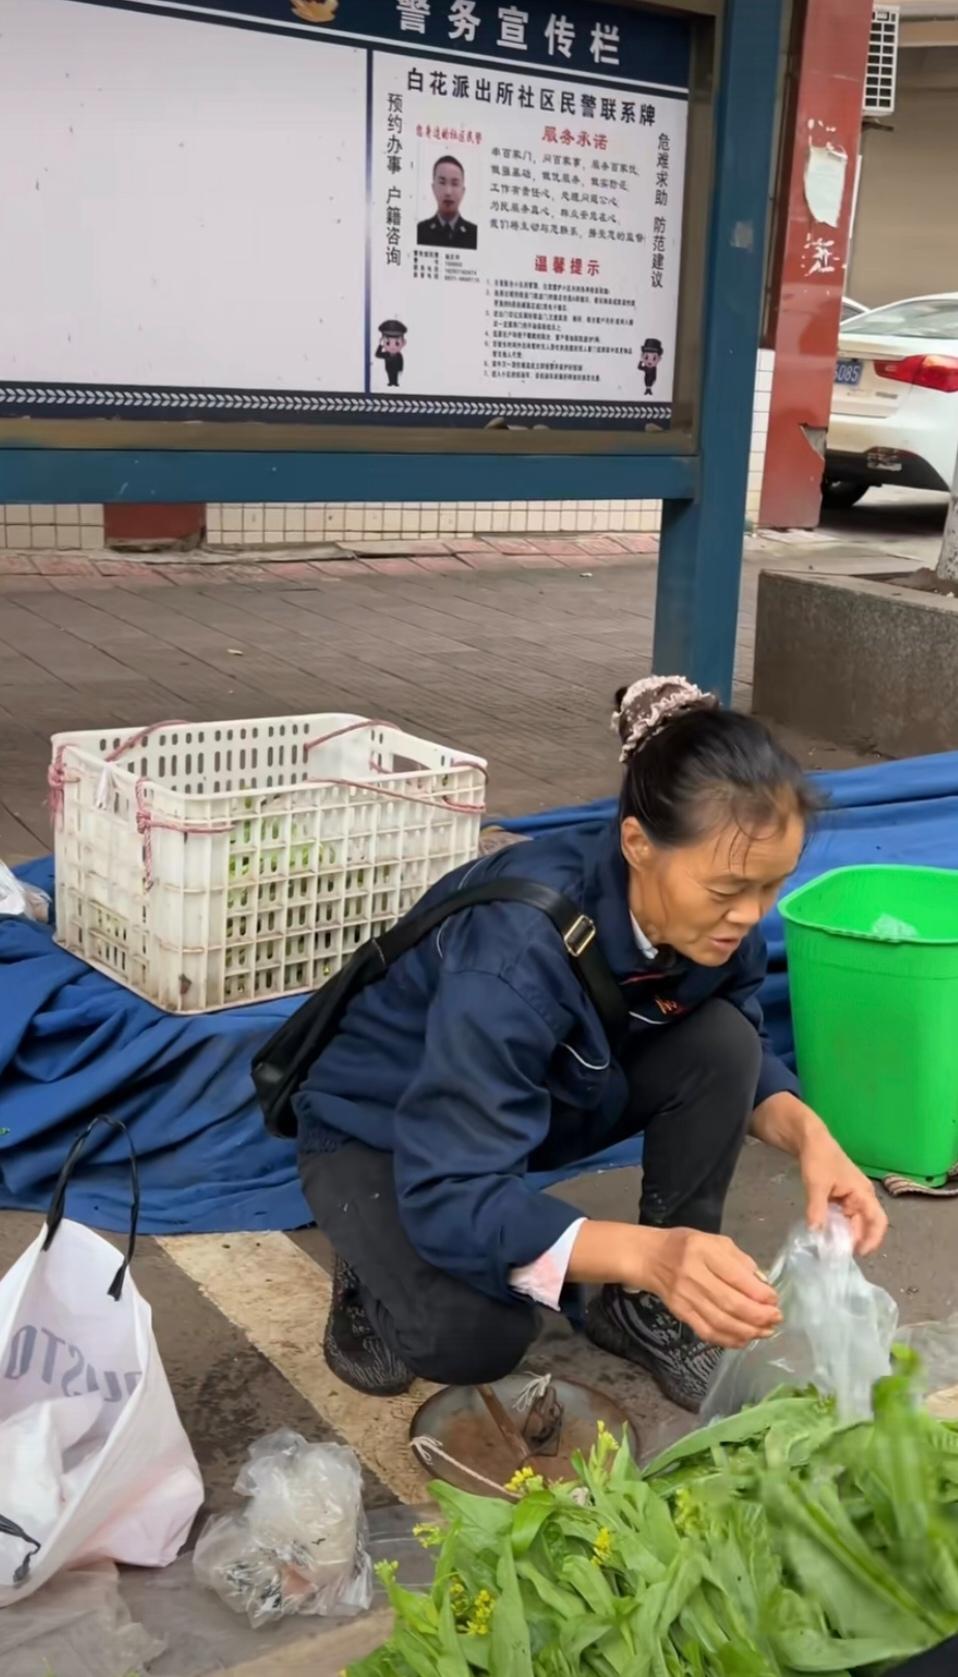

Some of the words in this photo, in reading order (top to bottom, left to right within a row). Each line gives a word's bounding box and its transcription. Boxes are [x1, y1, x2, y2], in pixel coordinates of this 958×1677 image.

[396, 0, 620, 65] 警务宣传栏
[407, 67, 656, 127] 白花派出所社区民警联系牌
[386, 92, 403, 175] 预约办事
[542, 126, 608, 150] 服务承诺
[654, 132, 671, 207] 危难求助
[385, 186, 402, 266] 户籍咨询
[650, 216, 667, 288] 防范建议
[535, 255, 600, 276] 温馨提示
